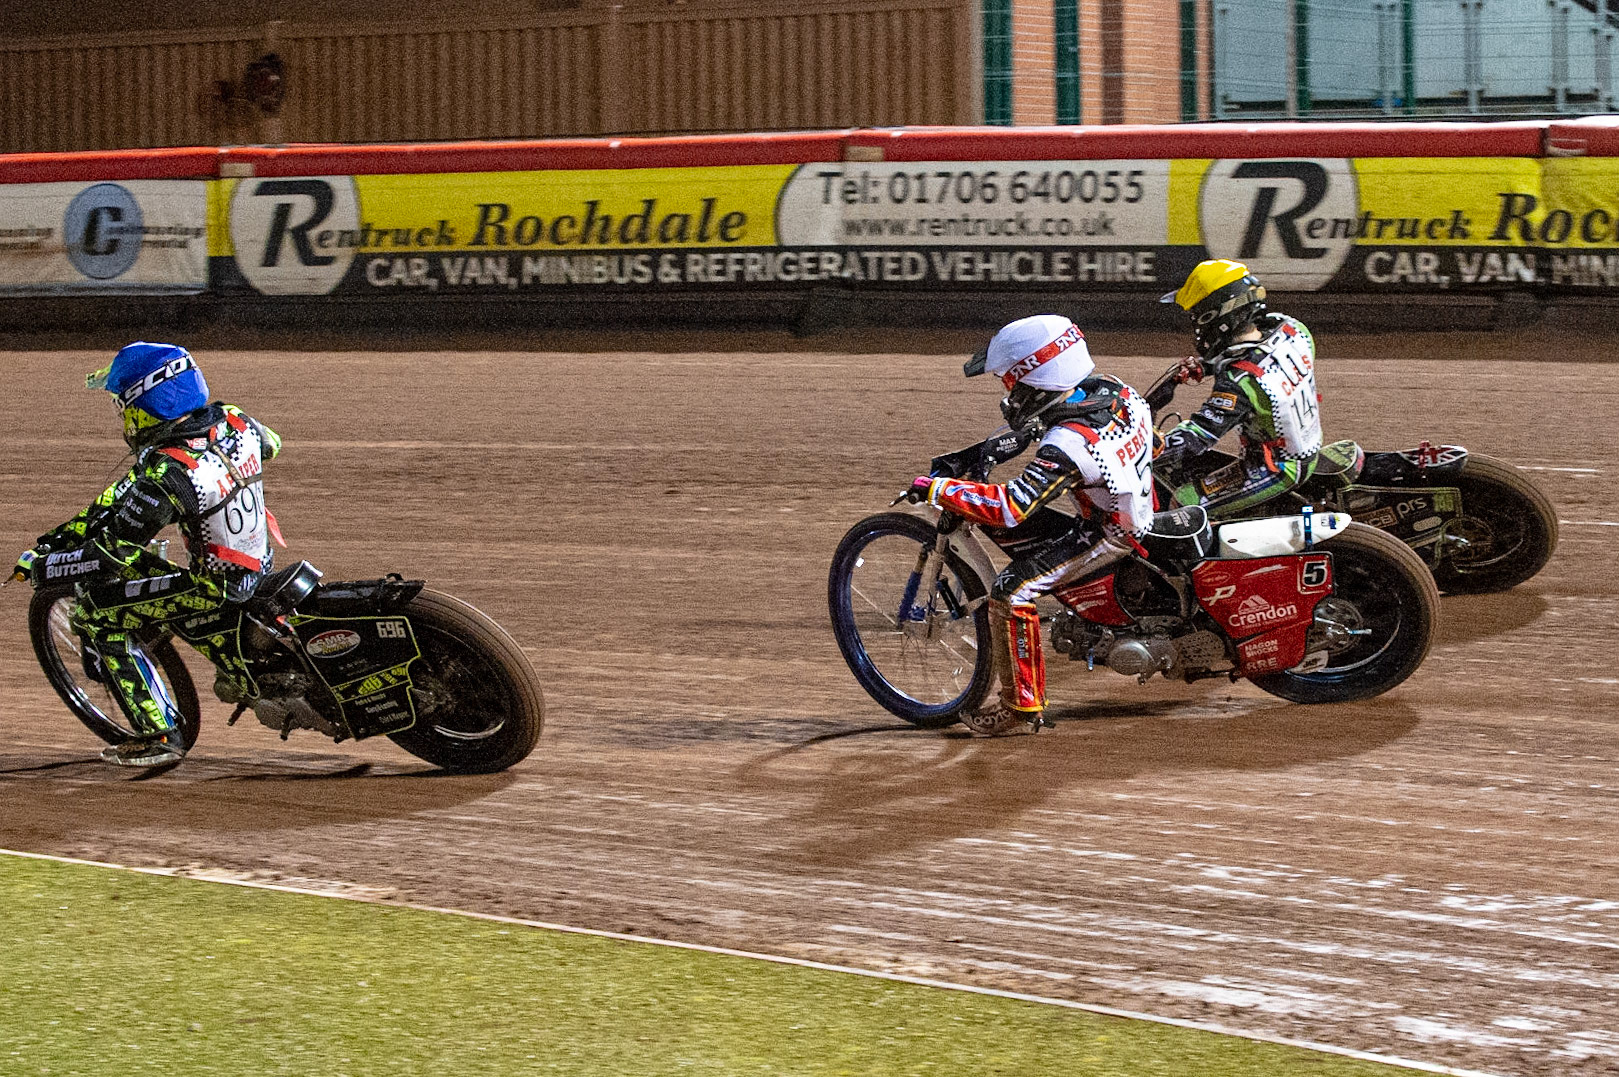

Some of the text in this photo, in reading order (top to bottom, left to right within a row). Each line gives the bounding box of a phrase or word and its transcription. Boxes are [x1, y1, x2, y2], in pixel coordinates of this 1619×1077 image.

[816, 170, 1145, 205] Tel: 01706 640055
[254, 180, 748, 267] Rentruck Rochdale
[842, 211, 1116, 238] www.rentruck.co.uk
[1231, 160, 1619, 259] Rentruck Roc
[366, 251, 1157, 291] CAR, VAN, MINIBUS & REFRIGERATED VEHICLE HIRE
[1363, 251, 1450, 288] CAR,
[999, 437, 1017, 447] MAX
[1116, 416, 1149, 467] PERRY
[46, 560, 100, 579] BUTCHER
[1302, 560, 1327, 587] 5
[375, 621, 407, 639] 696
[1228, 605, 1298, 627] Crendon
